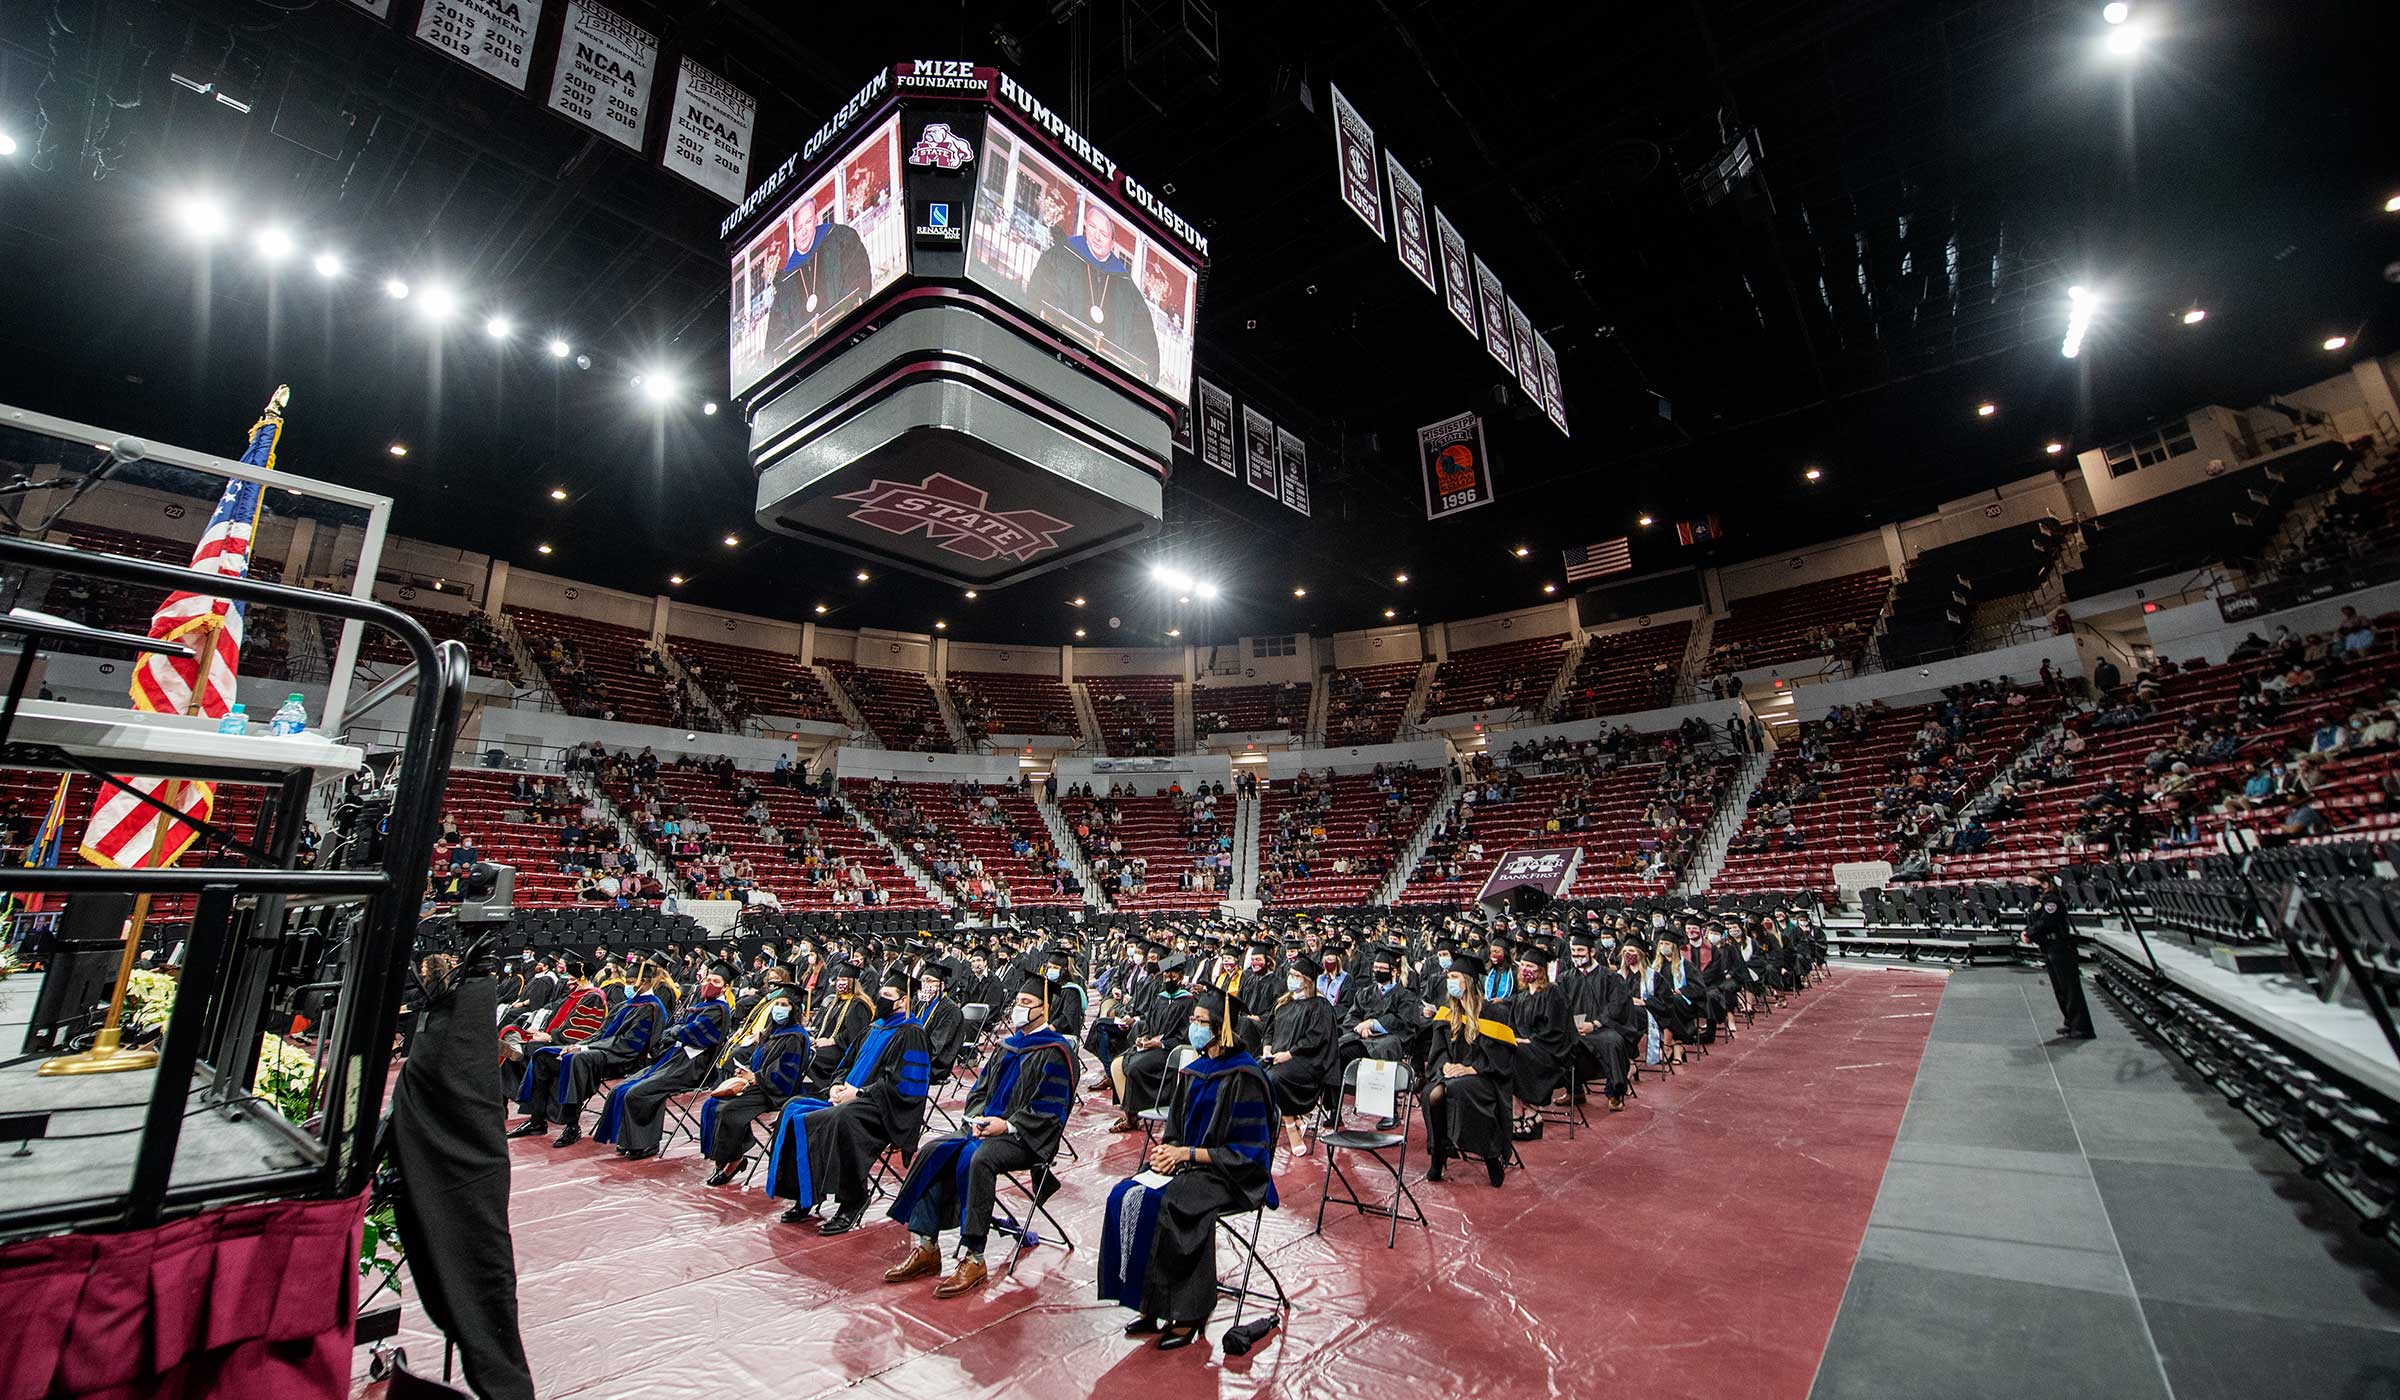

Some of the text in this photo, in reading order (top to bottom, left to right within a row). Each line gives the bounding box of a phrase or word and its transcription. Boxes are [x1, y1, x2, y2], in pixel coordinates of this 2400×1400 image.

[435, 1, 523, 55] 2015 2016
[574, 0, 659, 49] ISSISSIPPI
[592, 19, 633, 48] STATE
[430, 29, 470, 55] 2019
[432, 15, 521, 68] 2017 2018
[574, 24, 647, 69] WOMEN'S BASKETBALL
[575, 42, 637, 88] NCAA
[575, 60, 635, 98] SWEET 16
[913, 59, 974, 78] MIZE
[565, 72, 638, 117] 2010 2016
[681, 55, 757, 111] MISSISSIPPI
[700, 83, 735, 110] STATE
[897, 76, 988, 90] FOUNDATION
[560, 97, 592, 120] 2019
[562, 84, 636, 129] 2017 2018
[678, 116, 746, 161] ELITE EIGHT
[687, 104, 739, 147] NCAA
[676, 145, 703, 166] 2019
[678, 133, 740, 175] 2017 2018
[719, 66, 888, 240] HUMPHREY COLISEUM
[920, 148, 949, 158] STATE
[1000, 72, 1209, 257] HUMPHREY COLISEUM
[916, 226, 961, 236] RENASANT
[1210, 415, 1226, 434] NIT
[1438, 431, 1464, 444] STATE
[166, 505, 184, 517] 227
[1441, 489, 1477, 510] 1996
[1986, 504, 2001, 516] 203
[895, 497, 1024, 546] STATE
[399, 589, 415, 599] 228
